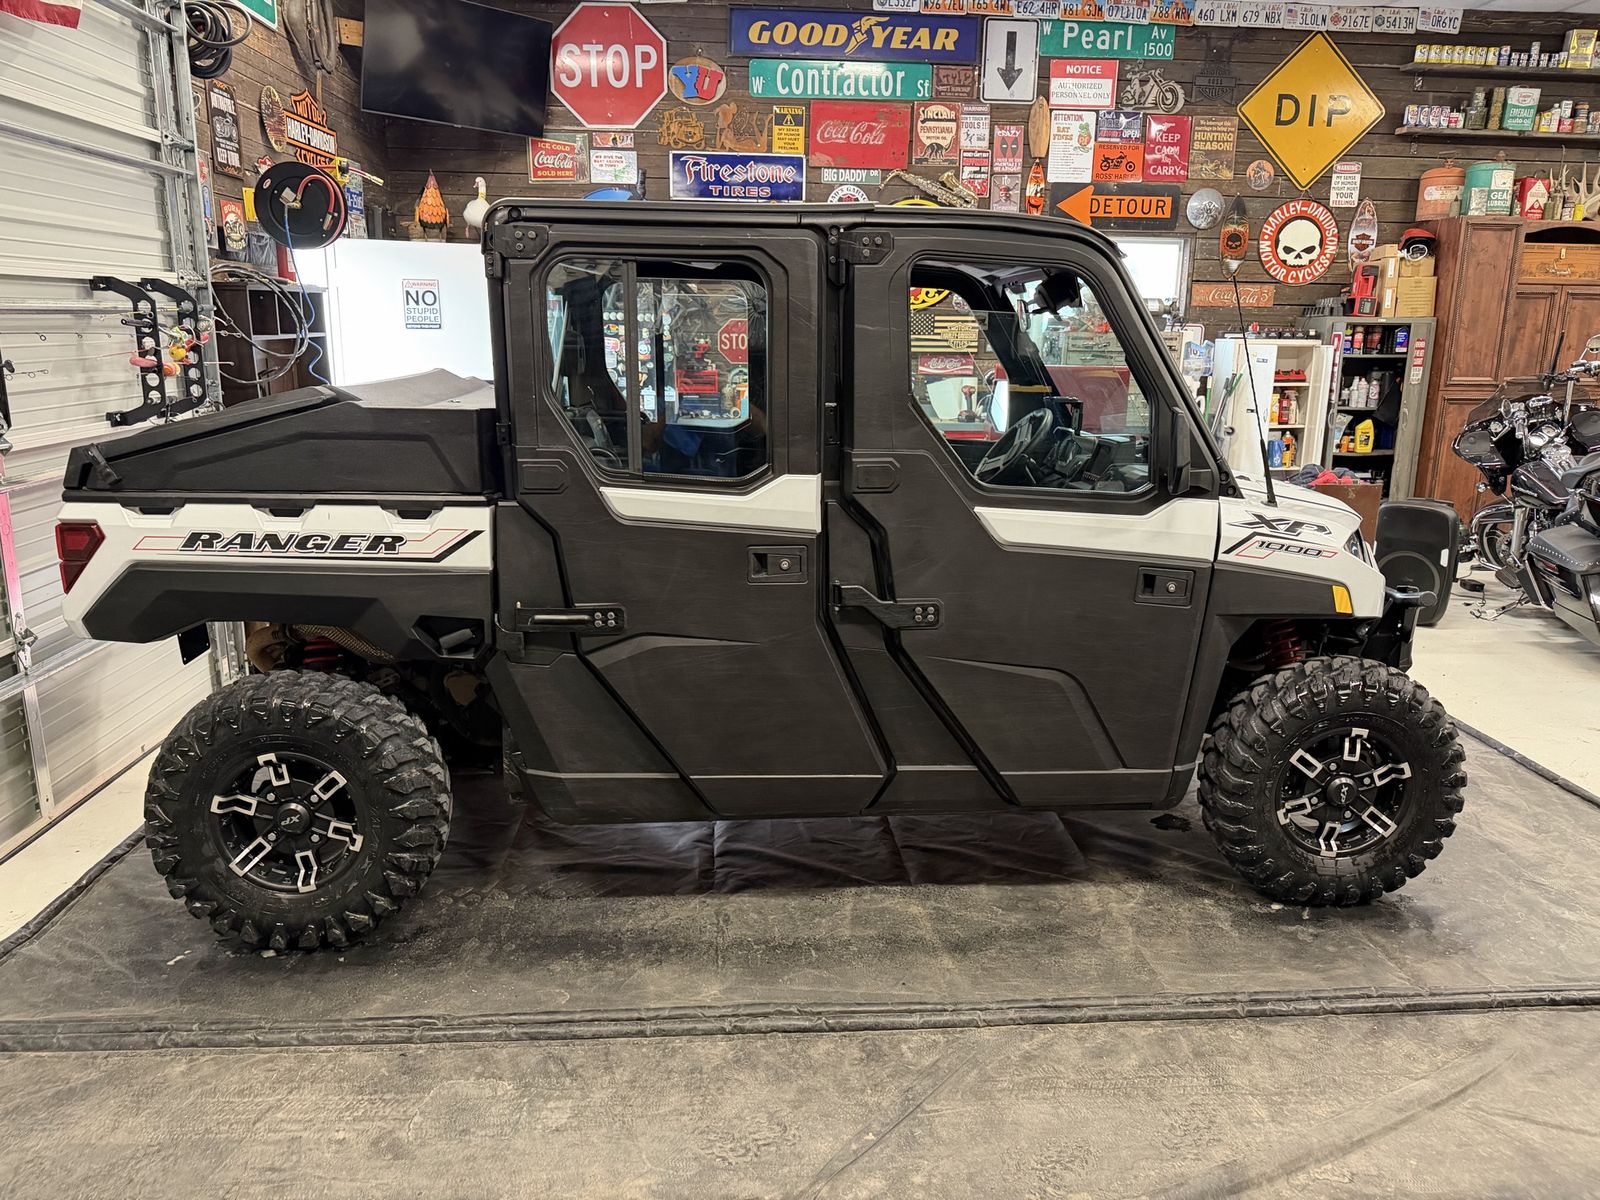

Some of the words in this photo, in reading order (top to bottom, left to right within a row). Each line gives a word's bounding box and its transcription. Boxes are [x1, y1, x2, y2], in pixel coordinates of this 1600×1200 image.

[1153, 6, 1169, 19] 788
[1197, 9, 1215, 22] 460
[1242, 11, 1260, 23] 679
[1265, 12, 1282, 24] NBX
[1341, 15, 1370, 28] 9167E
[1386, 16, 1415, 30] 5413H
[870, 25, 960, 51] YEAR
[1042, 21, 1053, 36] W
[1063, 22, 1133, 50] Pearl
[1151, 27, 1168, 40] Av
[1143, 42, 1172, 57] 1500
[559, 44, 658, 89] STOP
[1066, 64, 1102, 75] NOTICE
[752, 75, 764, 94] W
[776, 61, 906, 98] Contractor
[917, 79, 930, 98] St
[1057, 81, 1103, 91] AUTHORIZED
[1092, 91, 1111, 101] ONLY
[919, 107, 956, 120] SINCLAIR
[1275, 91, 1353, 128] DIP
[1510, 108, 1534, 117] EMERALD
[287, 116, 337, 157] HARLEY-DAVIDSON
[816, 121, 885, 145] Coca-Cola
[920, 126, 953, 135] PENNSYLVANIA
[1156, 133, 1181, 143] KEEP
[1194, 132, 1234, 141] HUNTING
[1193, 141, 1233, 151] SEASON!
[534, 150, 574, 169] Coca-Cola
[680, 155, 797, 185] Firestone
[823, 169, 837, 181] BIG
[839, 170, 867, 182] DADDY
[1150, 165, 1181, 175] CARRY
[708, 185, 772, 197] TIRES
[1090, 196, 1166, 216] DETOUR
[1263, 200, 1338, 254] HARLEY-DAVIDSON
[1260, 241, 1287, 281] MOTOR
[1288, 255, 1331, 283] CYCLES
[405, 290, 437, 306] NO
[721, 333, 748, 350] STO
[1226, 510, 1332, 537] XP
[179, 529, 407, 554] RANGER
[1256, 540, 1322, 558] 1000
